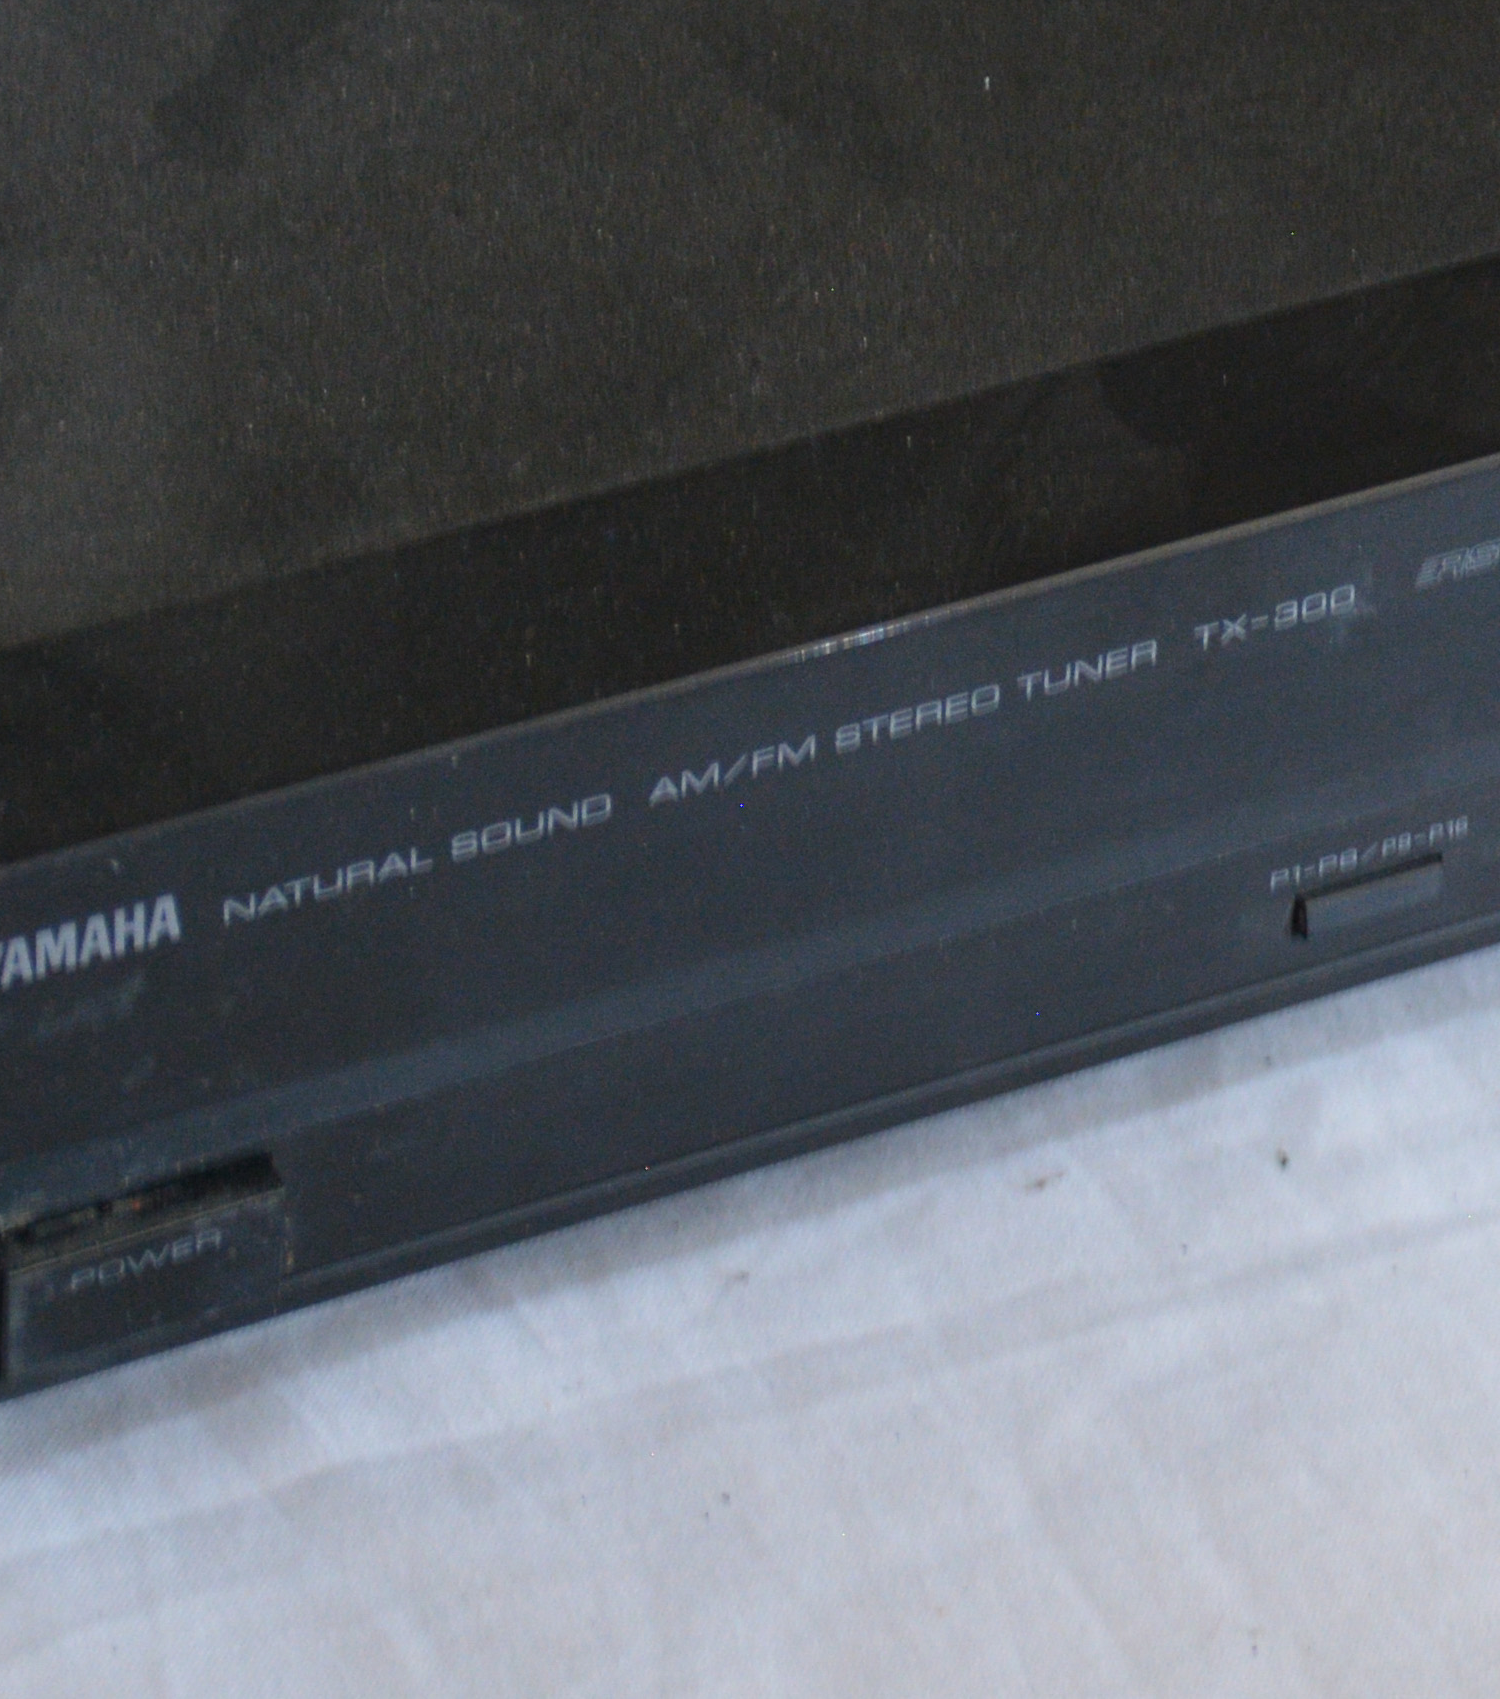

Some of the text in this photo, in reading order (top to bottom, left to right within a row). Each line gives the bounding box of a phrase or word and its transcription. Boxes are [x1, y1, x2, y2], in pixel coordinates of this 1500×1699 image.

[221, 583, 1358, 924] NATURAL SOUND AM/FM STEREO TUNER TX-300
[68, 1228, 224, 1292] POWER
